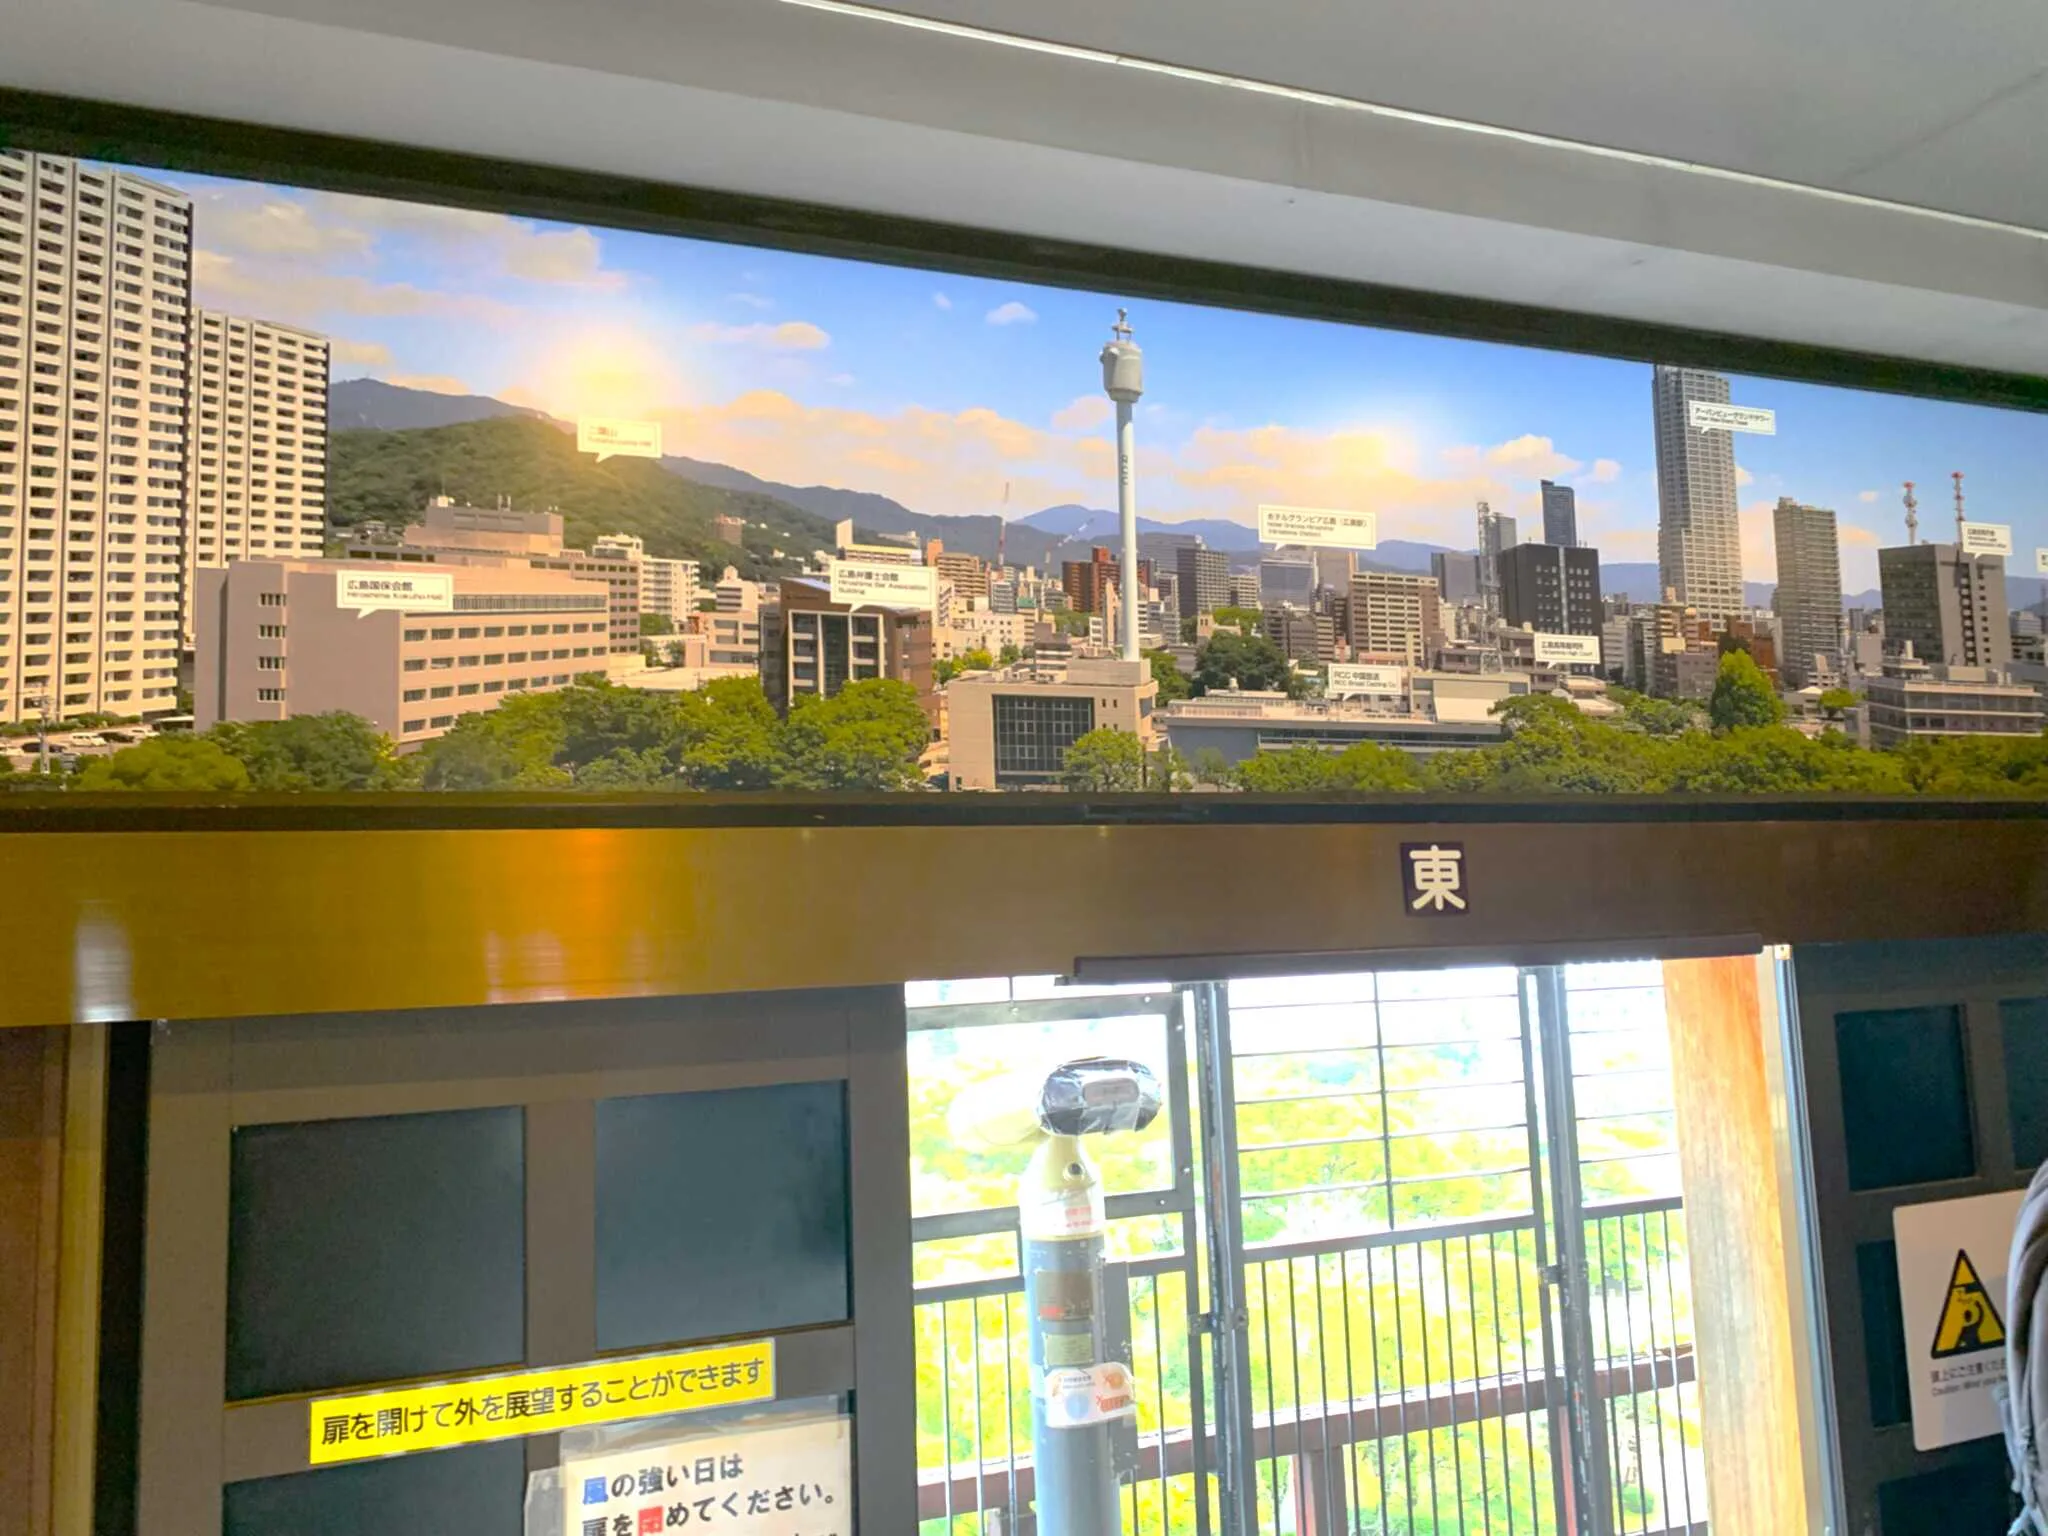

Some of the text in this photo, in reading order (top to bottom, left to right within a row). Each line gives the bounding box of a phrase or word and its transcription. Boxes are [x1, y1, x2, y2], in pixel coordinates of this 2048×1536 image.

[347, 580, 413, 591] 広島国保会館
[1333, 671, 1351, 679] RCC
[1408, 844, 1466, 911] 東
[1930, 1358, 2006, 1383] 頭上にご注意くださ
[321, 1357, 765, 1446] 扉を開けて外を展望することができます
[582, 1453, 744, 1505] 風の強い日は
